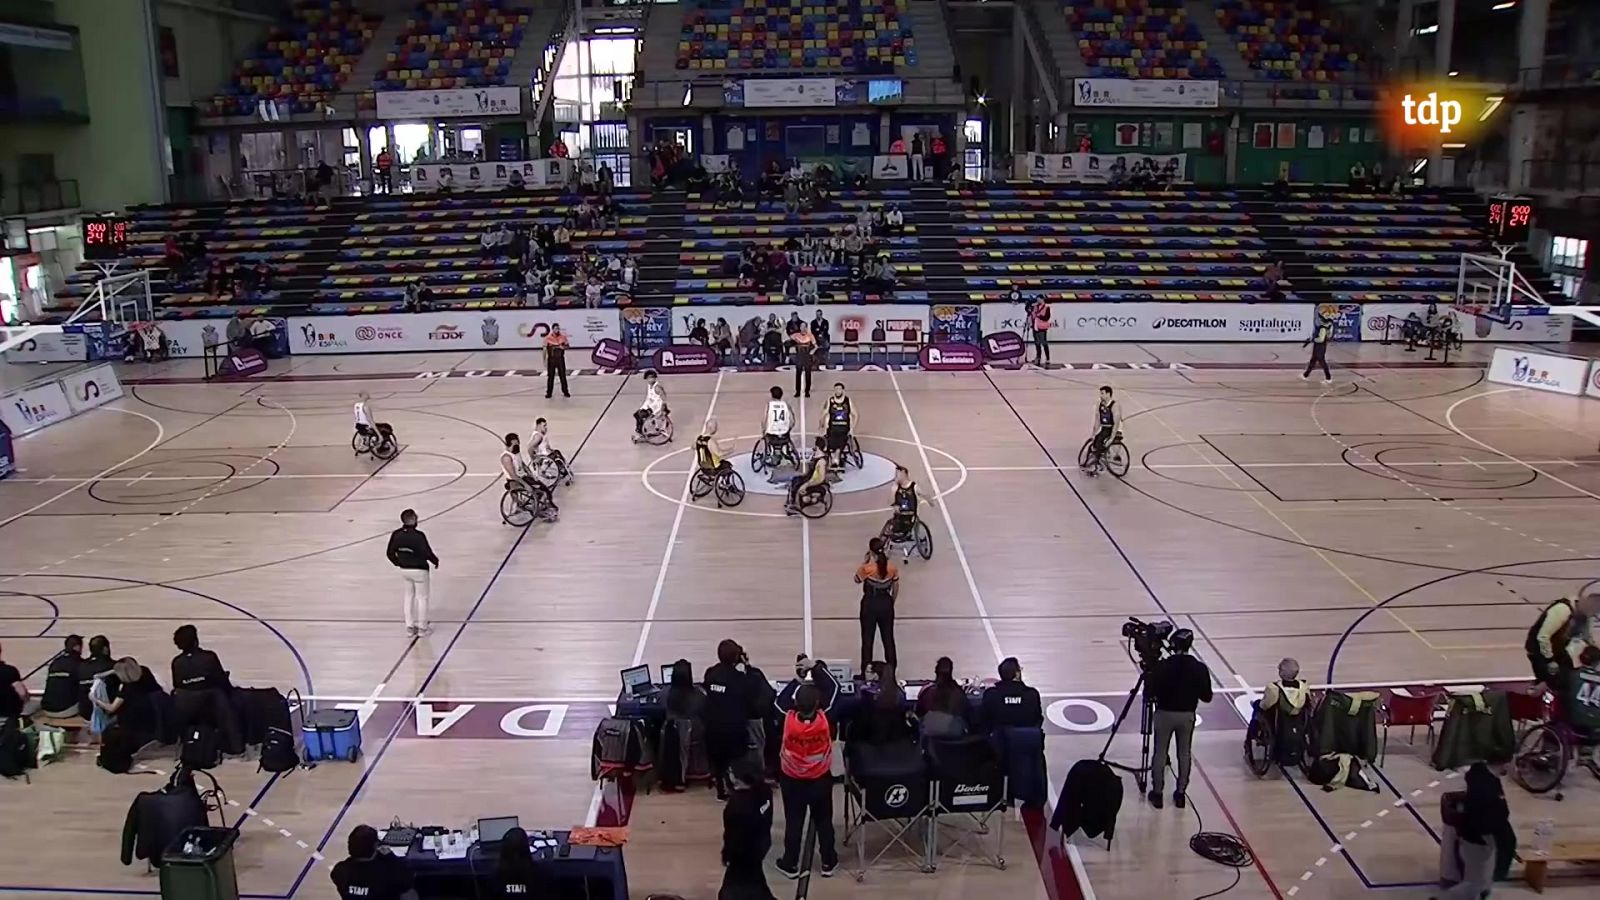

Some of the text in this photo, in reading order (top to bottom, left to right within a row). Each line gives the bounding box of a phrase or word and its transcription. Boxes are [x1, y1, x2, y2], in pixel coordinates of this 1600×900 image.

[1510, 213, 1529, 226] 24
[87, 232, 103, 243] 24
[1167, 319, 1227, 328] DECATHLON
[377, 331, 404, 339] ONCE
[773, 410, 785, 422] 14
[506, 884, 527, 893] STAFF
